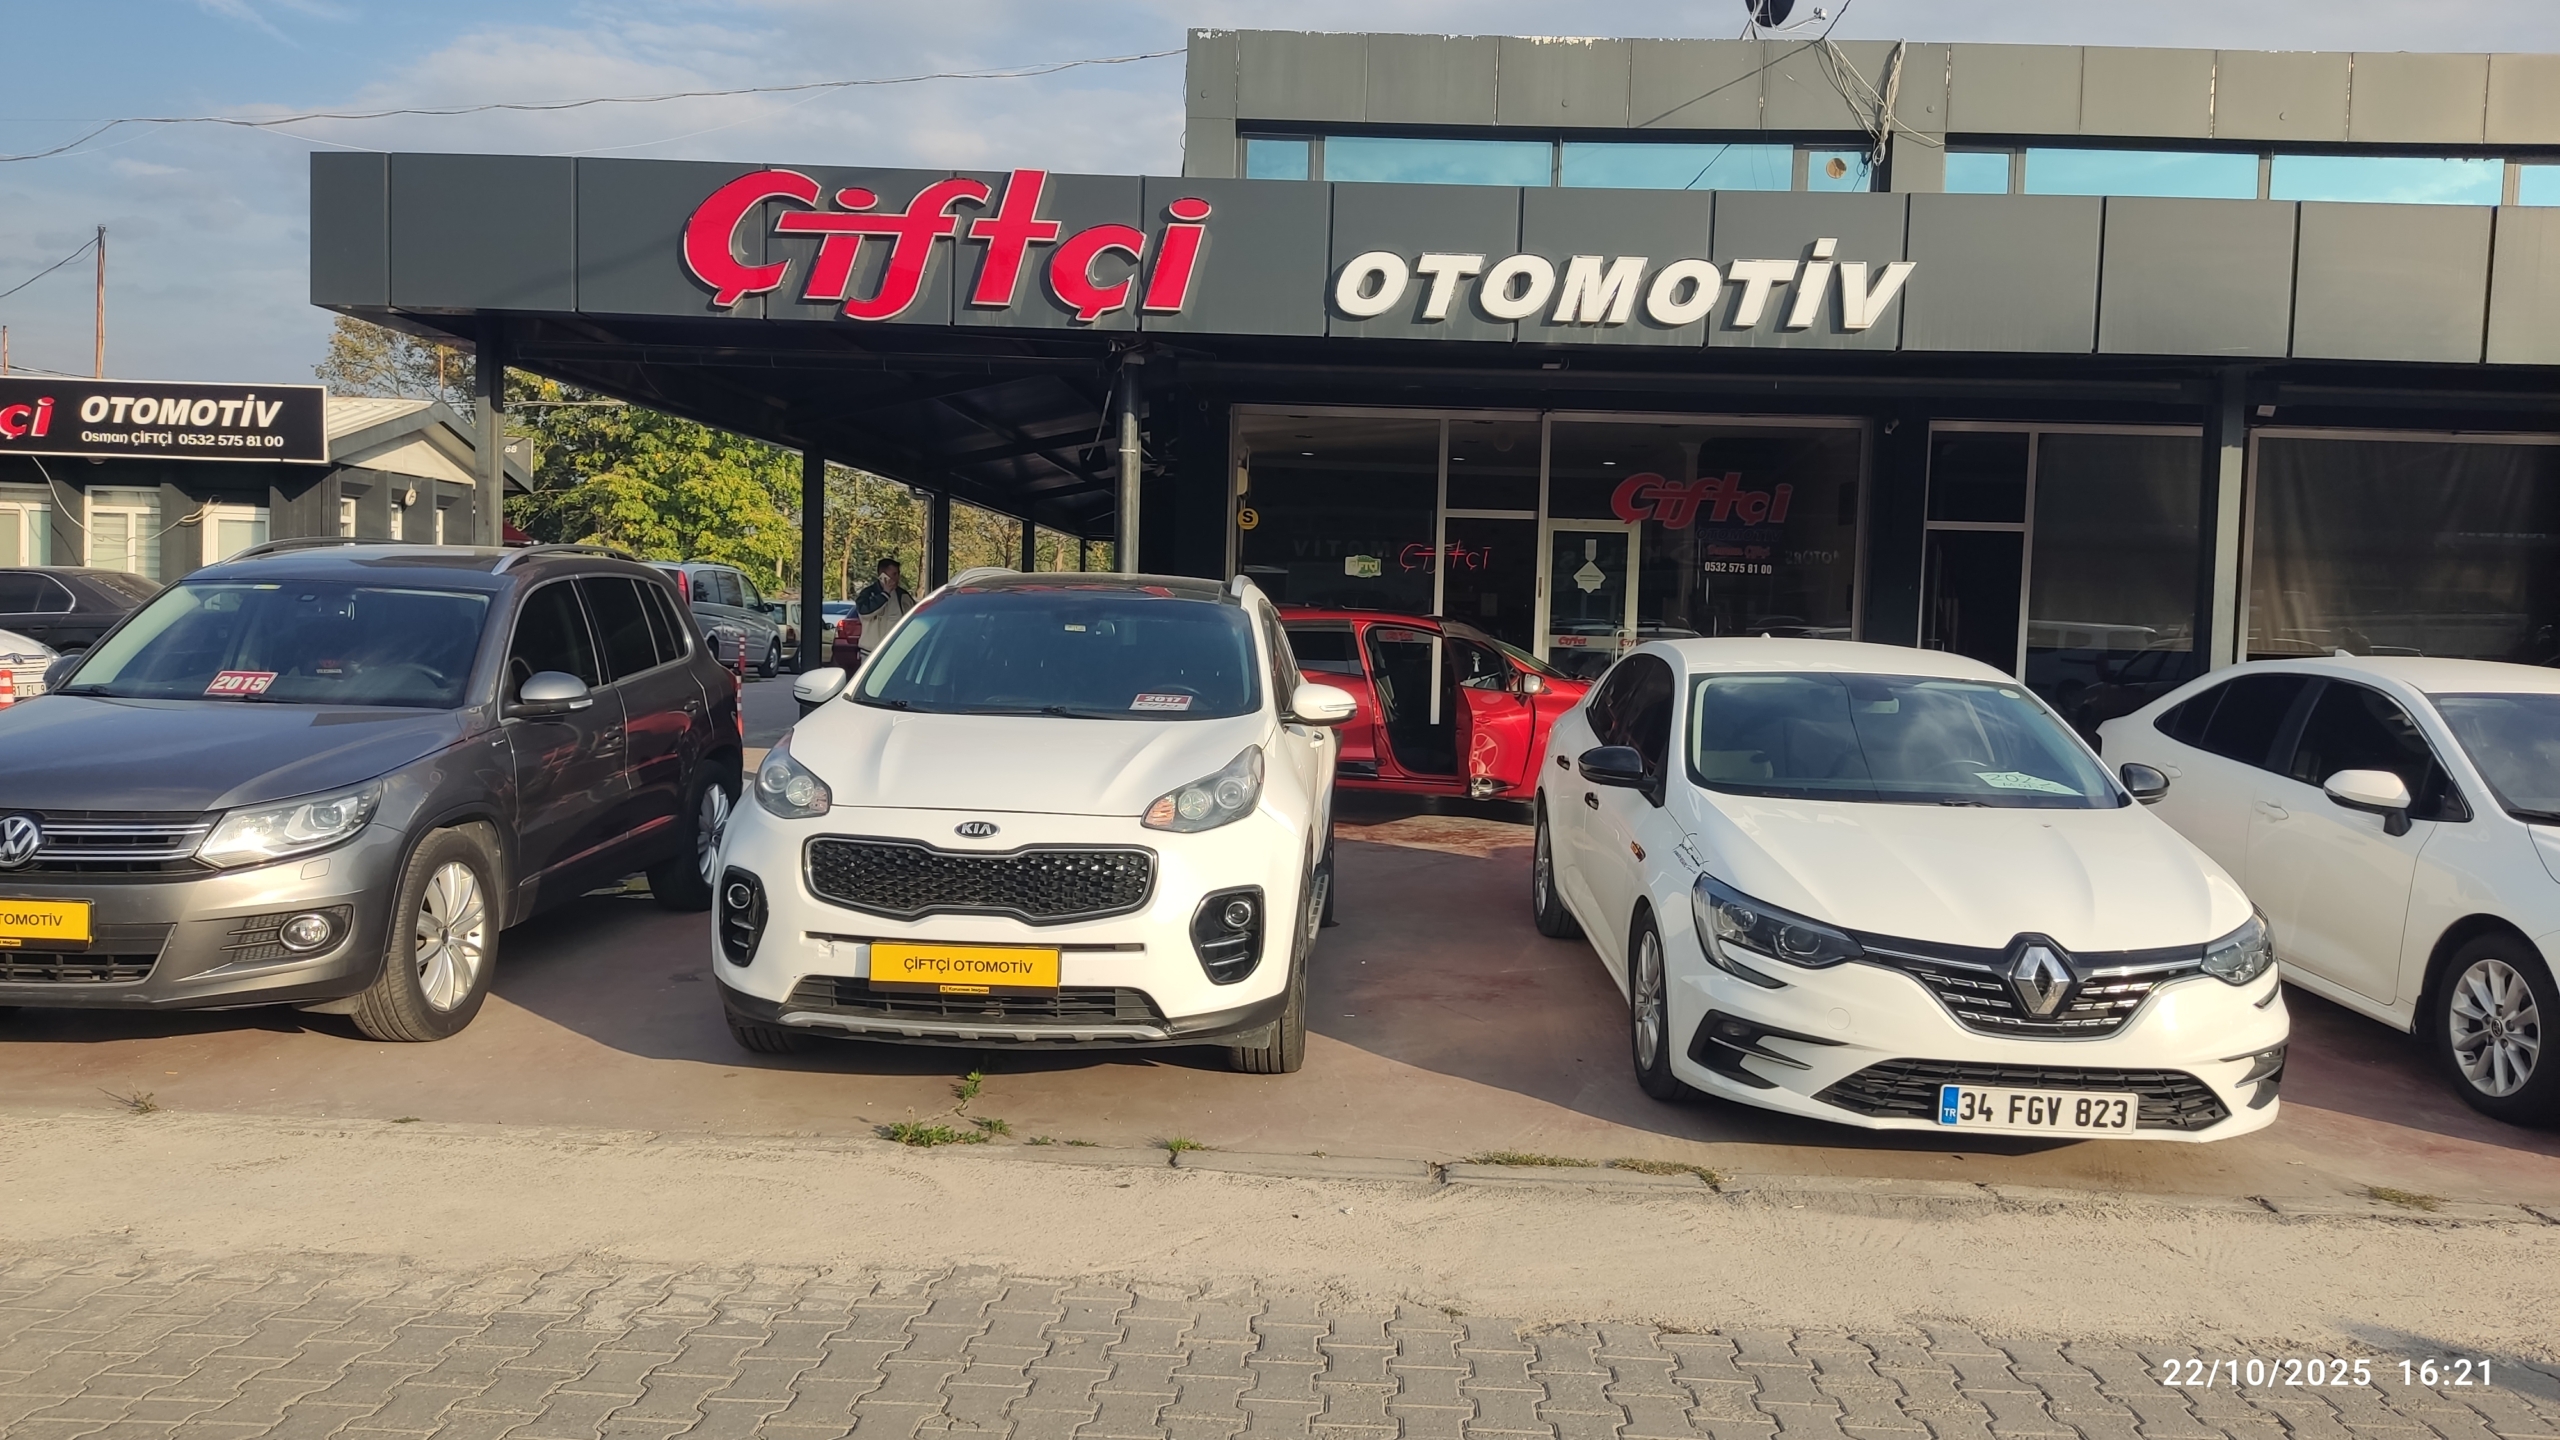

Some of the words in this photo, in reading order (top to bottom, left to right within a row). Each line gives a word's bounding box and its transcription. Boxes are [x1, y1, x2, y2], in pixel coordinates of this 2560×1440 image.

[683, 168, 1213, 321] Çiftçi
[1334, 237, 1917, 329] OTOMOTİV
[81, 394, 283, 427] OTOMOTİV
[81, 431, 128, 444] Osman
[130, 430, 172, 446] ÇİFTÇİ
[178, 433, 215, 445] 0532
[218, 434, 243, 446] 575
[246, 435, 261, 447] 81
[264, 435, 284, 447] 00
[1610, 472, 1793, 530] Çiftçi
[1242, 510, 1254, 523] S
[1704, 562, 1727, 572] 0532
[1728, 563, 1745, 573] 575
[1747, 564, 1759, 574] 81
[1760, 564, 1772, 575] 00
[211, 675, 269, 691] 2015
[1143, 695, 1182, 703] 2017
[960, 823, 992, 835] KIA
[0, 913, 63, 926] OMOTİV
[904, 956, 950, 974] ÇİFTÇİ
[953, 959, 1033, 974] OTOMOTİV
[1944, 1107, 1956, 1117] TR
[1960, 1092, 1993, 1122] 34
[2008, 1094, 2062, 1126] FGV
[2075, 1098, 2128, 1128] 823
